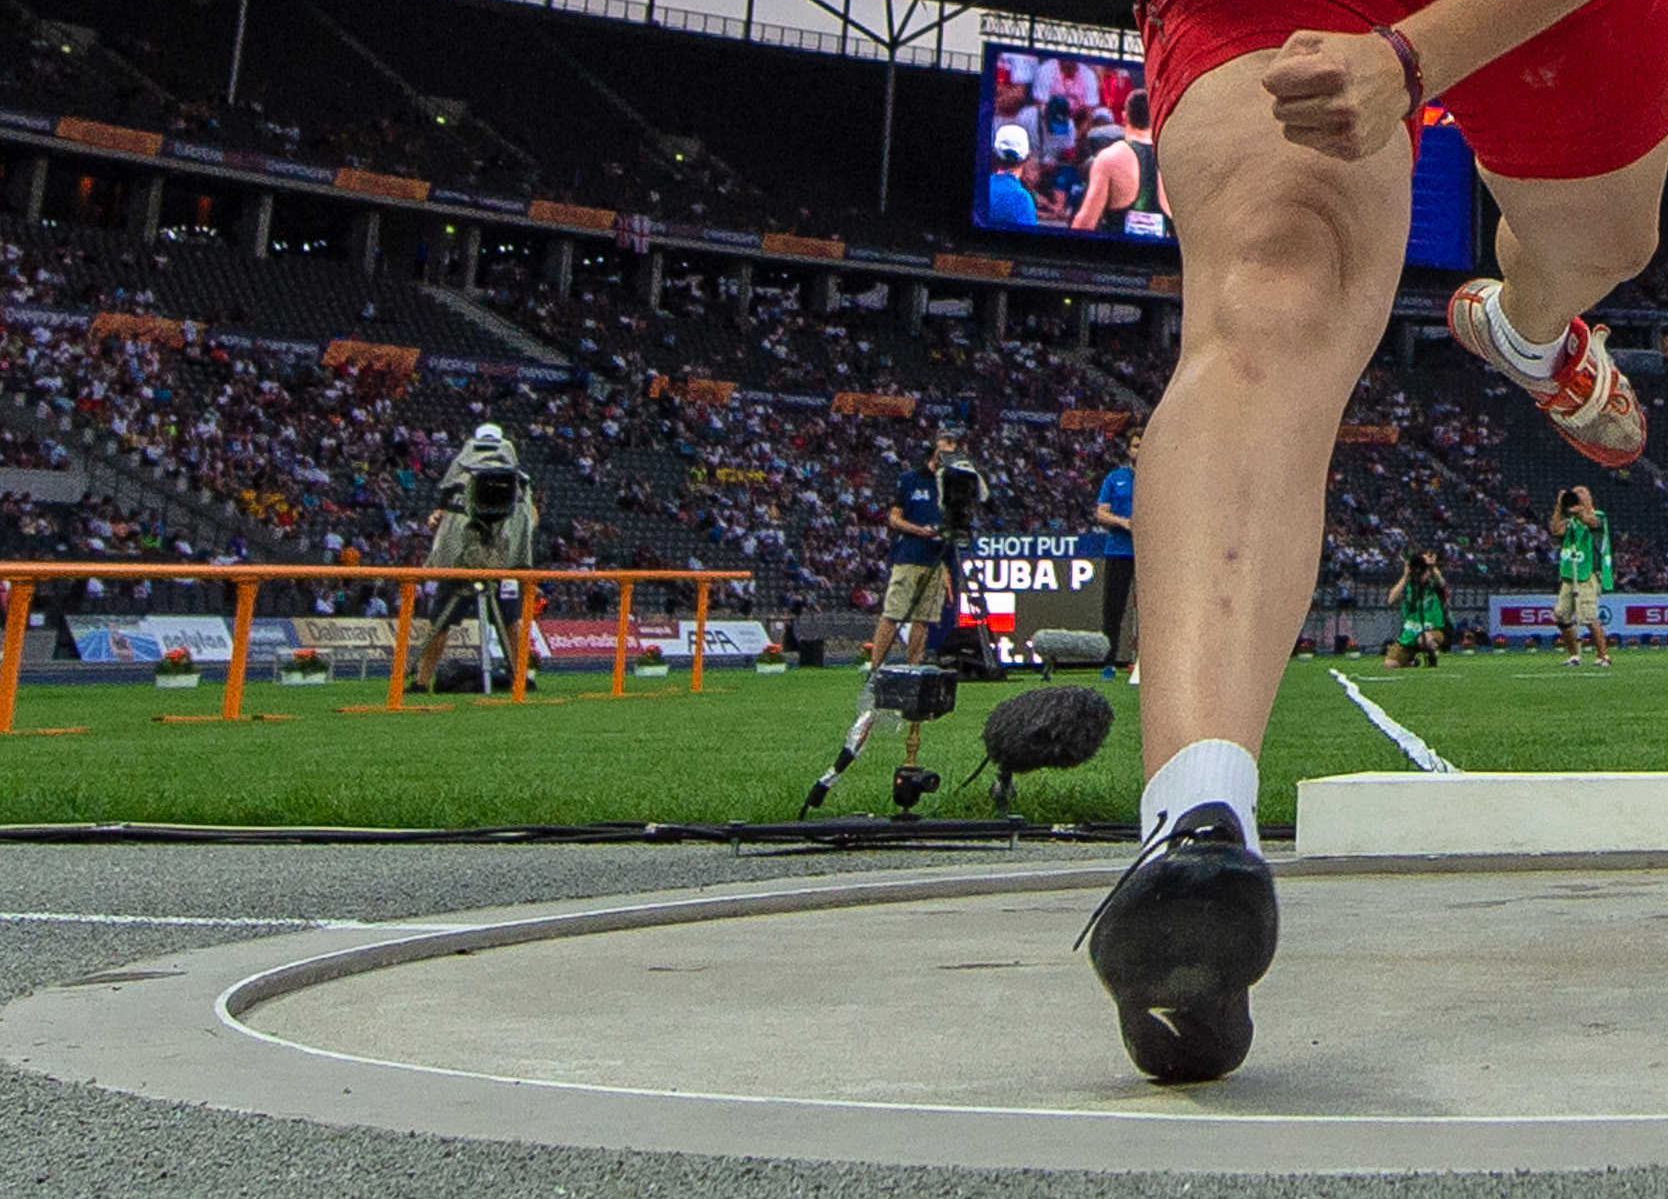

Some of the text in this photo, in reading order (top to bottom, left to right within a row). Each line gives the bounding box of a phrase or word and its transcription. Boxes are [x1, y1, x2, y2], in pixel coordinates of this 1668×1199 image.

[977, 536, 1079, 556] SHOT PUT
[1071, 559, 1094, 590] P
[306, 620, 379, 646] Dallmayr
